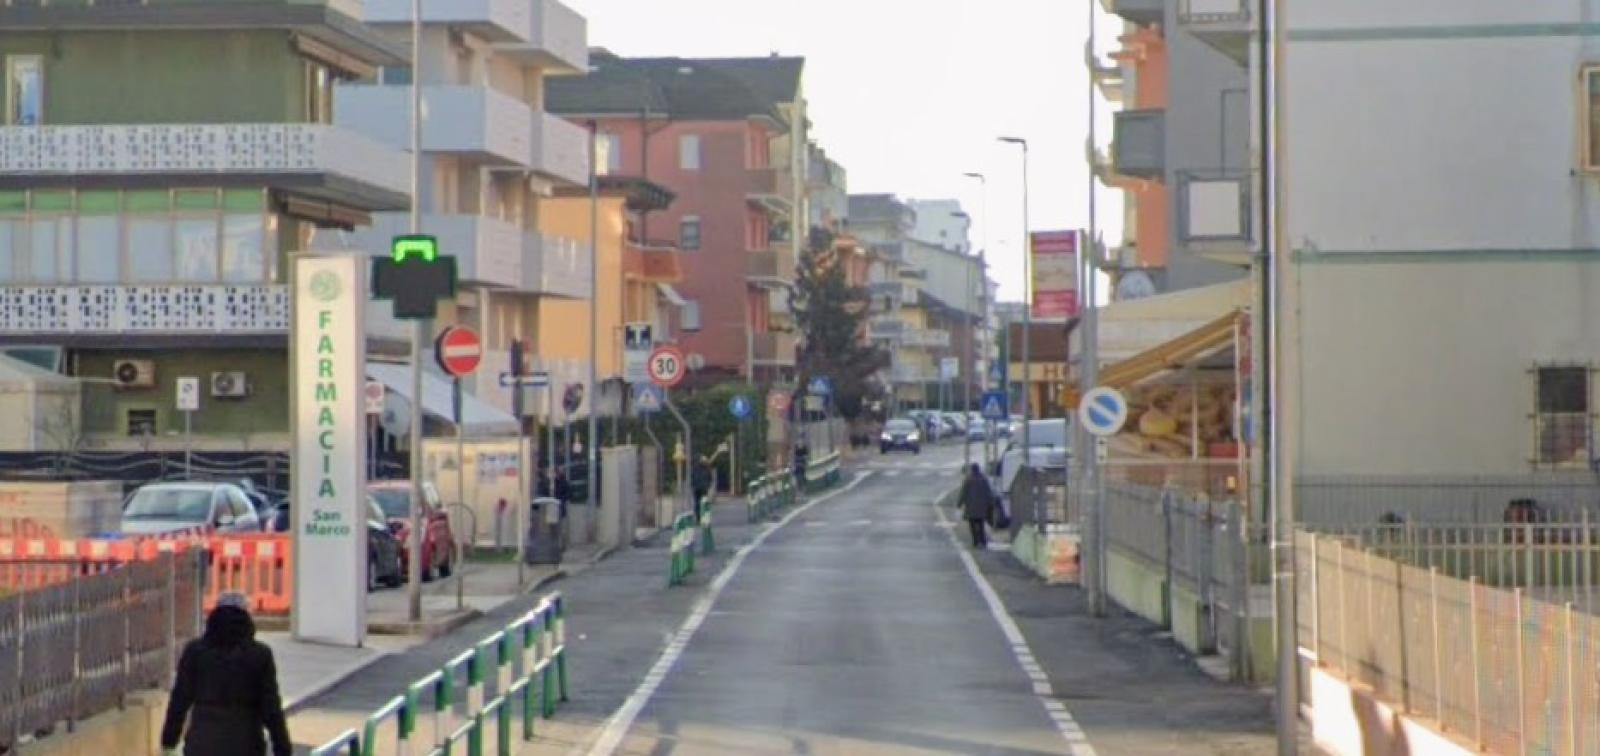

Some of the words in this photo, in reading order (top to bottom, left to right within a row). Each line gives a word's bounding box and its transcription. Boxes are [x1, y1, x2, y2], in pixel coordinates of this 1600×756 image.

[656, 357, 676, 376] 30
[316, 310, 337, 498] FARMACIA
[312, 510, 341, 521] San
[305, 523, 350, 536] Marco
